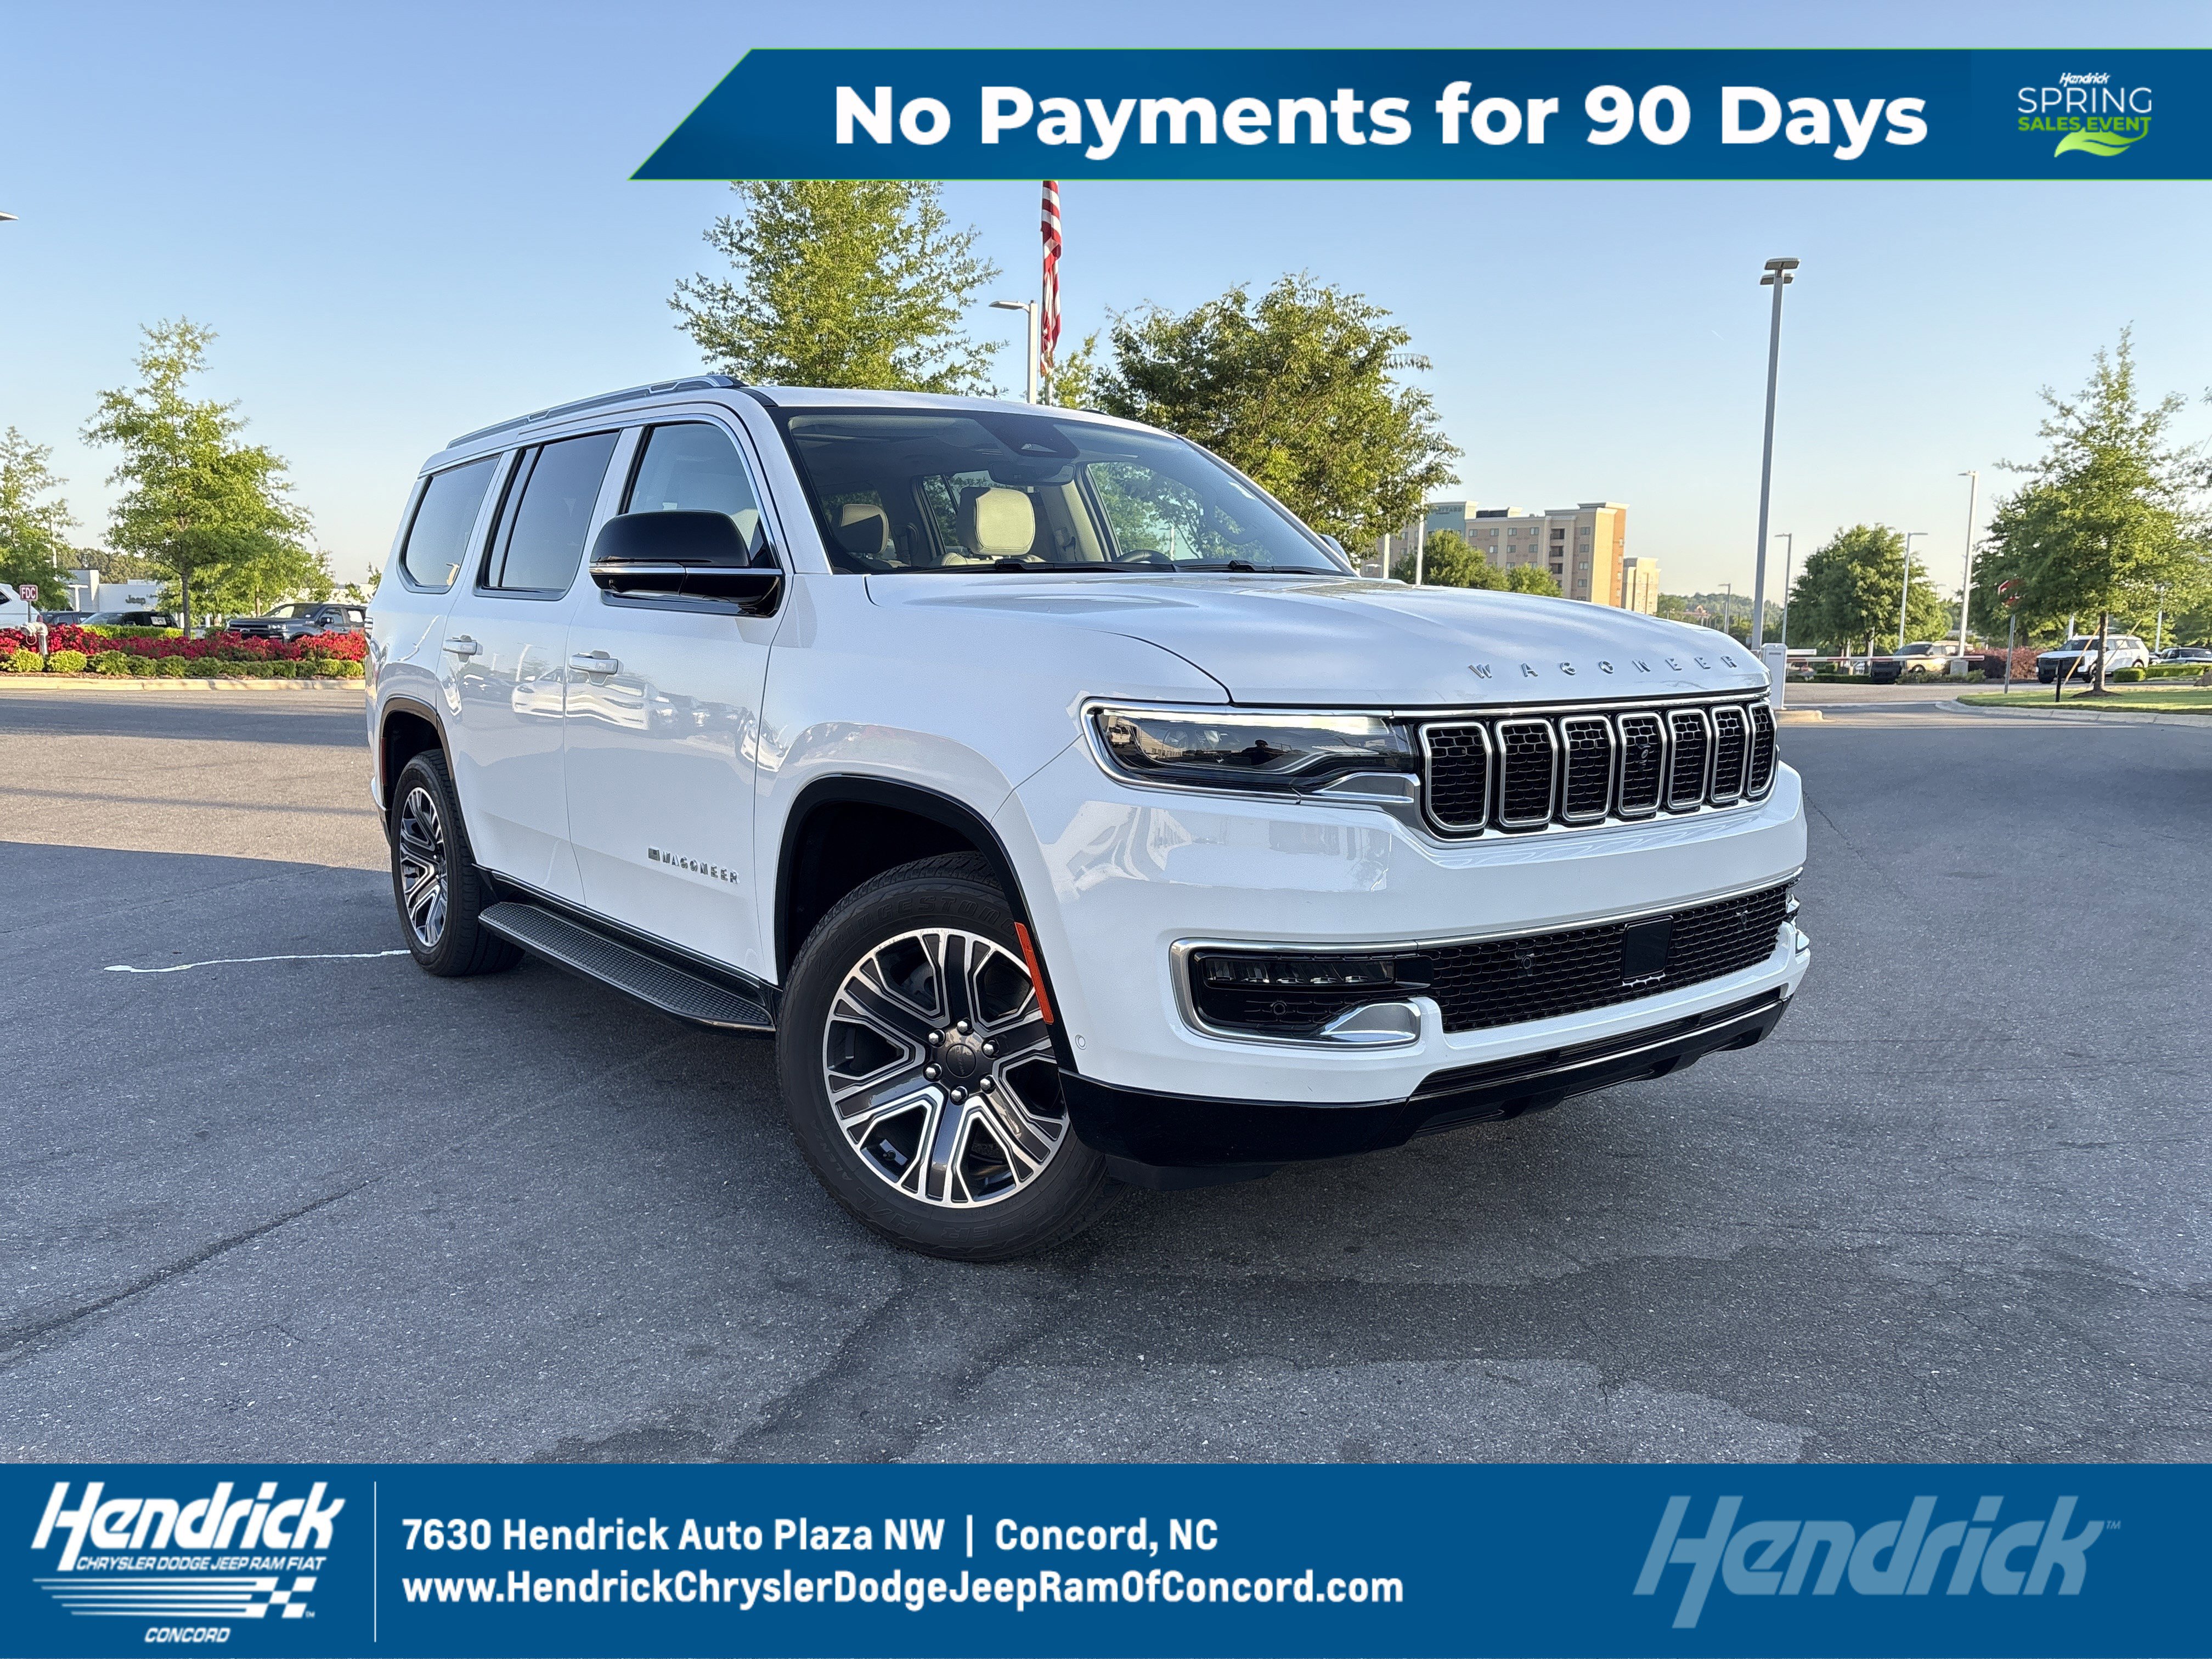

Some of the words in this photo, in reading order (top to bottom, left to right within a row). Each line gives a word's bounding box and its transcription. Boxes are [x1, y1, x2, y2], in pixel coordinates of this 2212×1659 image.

[21, 586, 36, 599] FDC
[125, 594, 146, 606] Jeep
[1468, 655, 1738, 679] WAGONEER
[660, 850, 741, 885] WAGONEER
